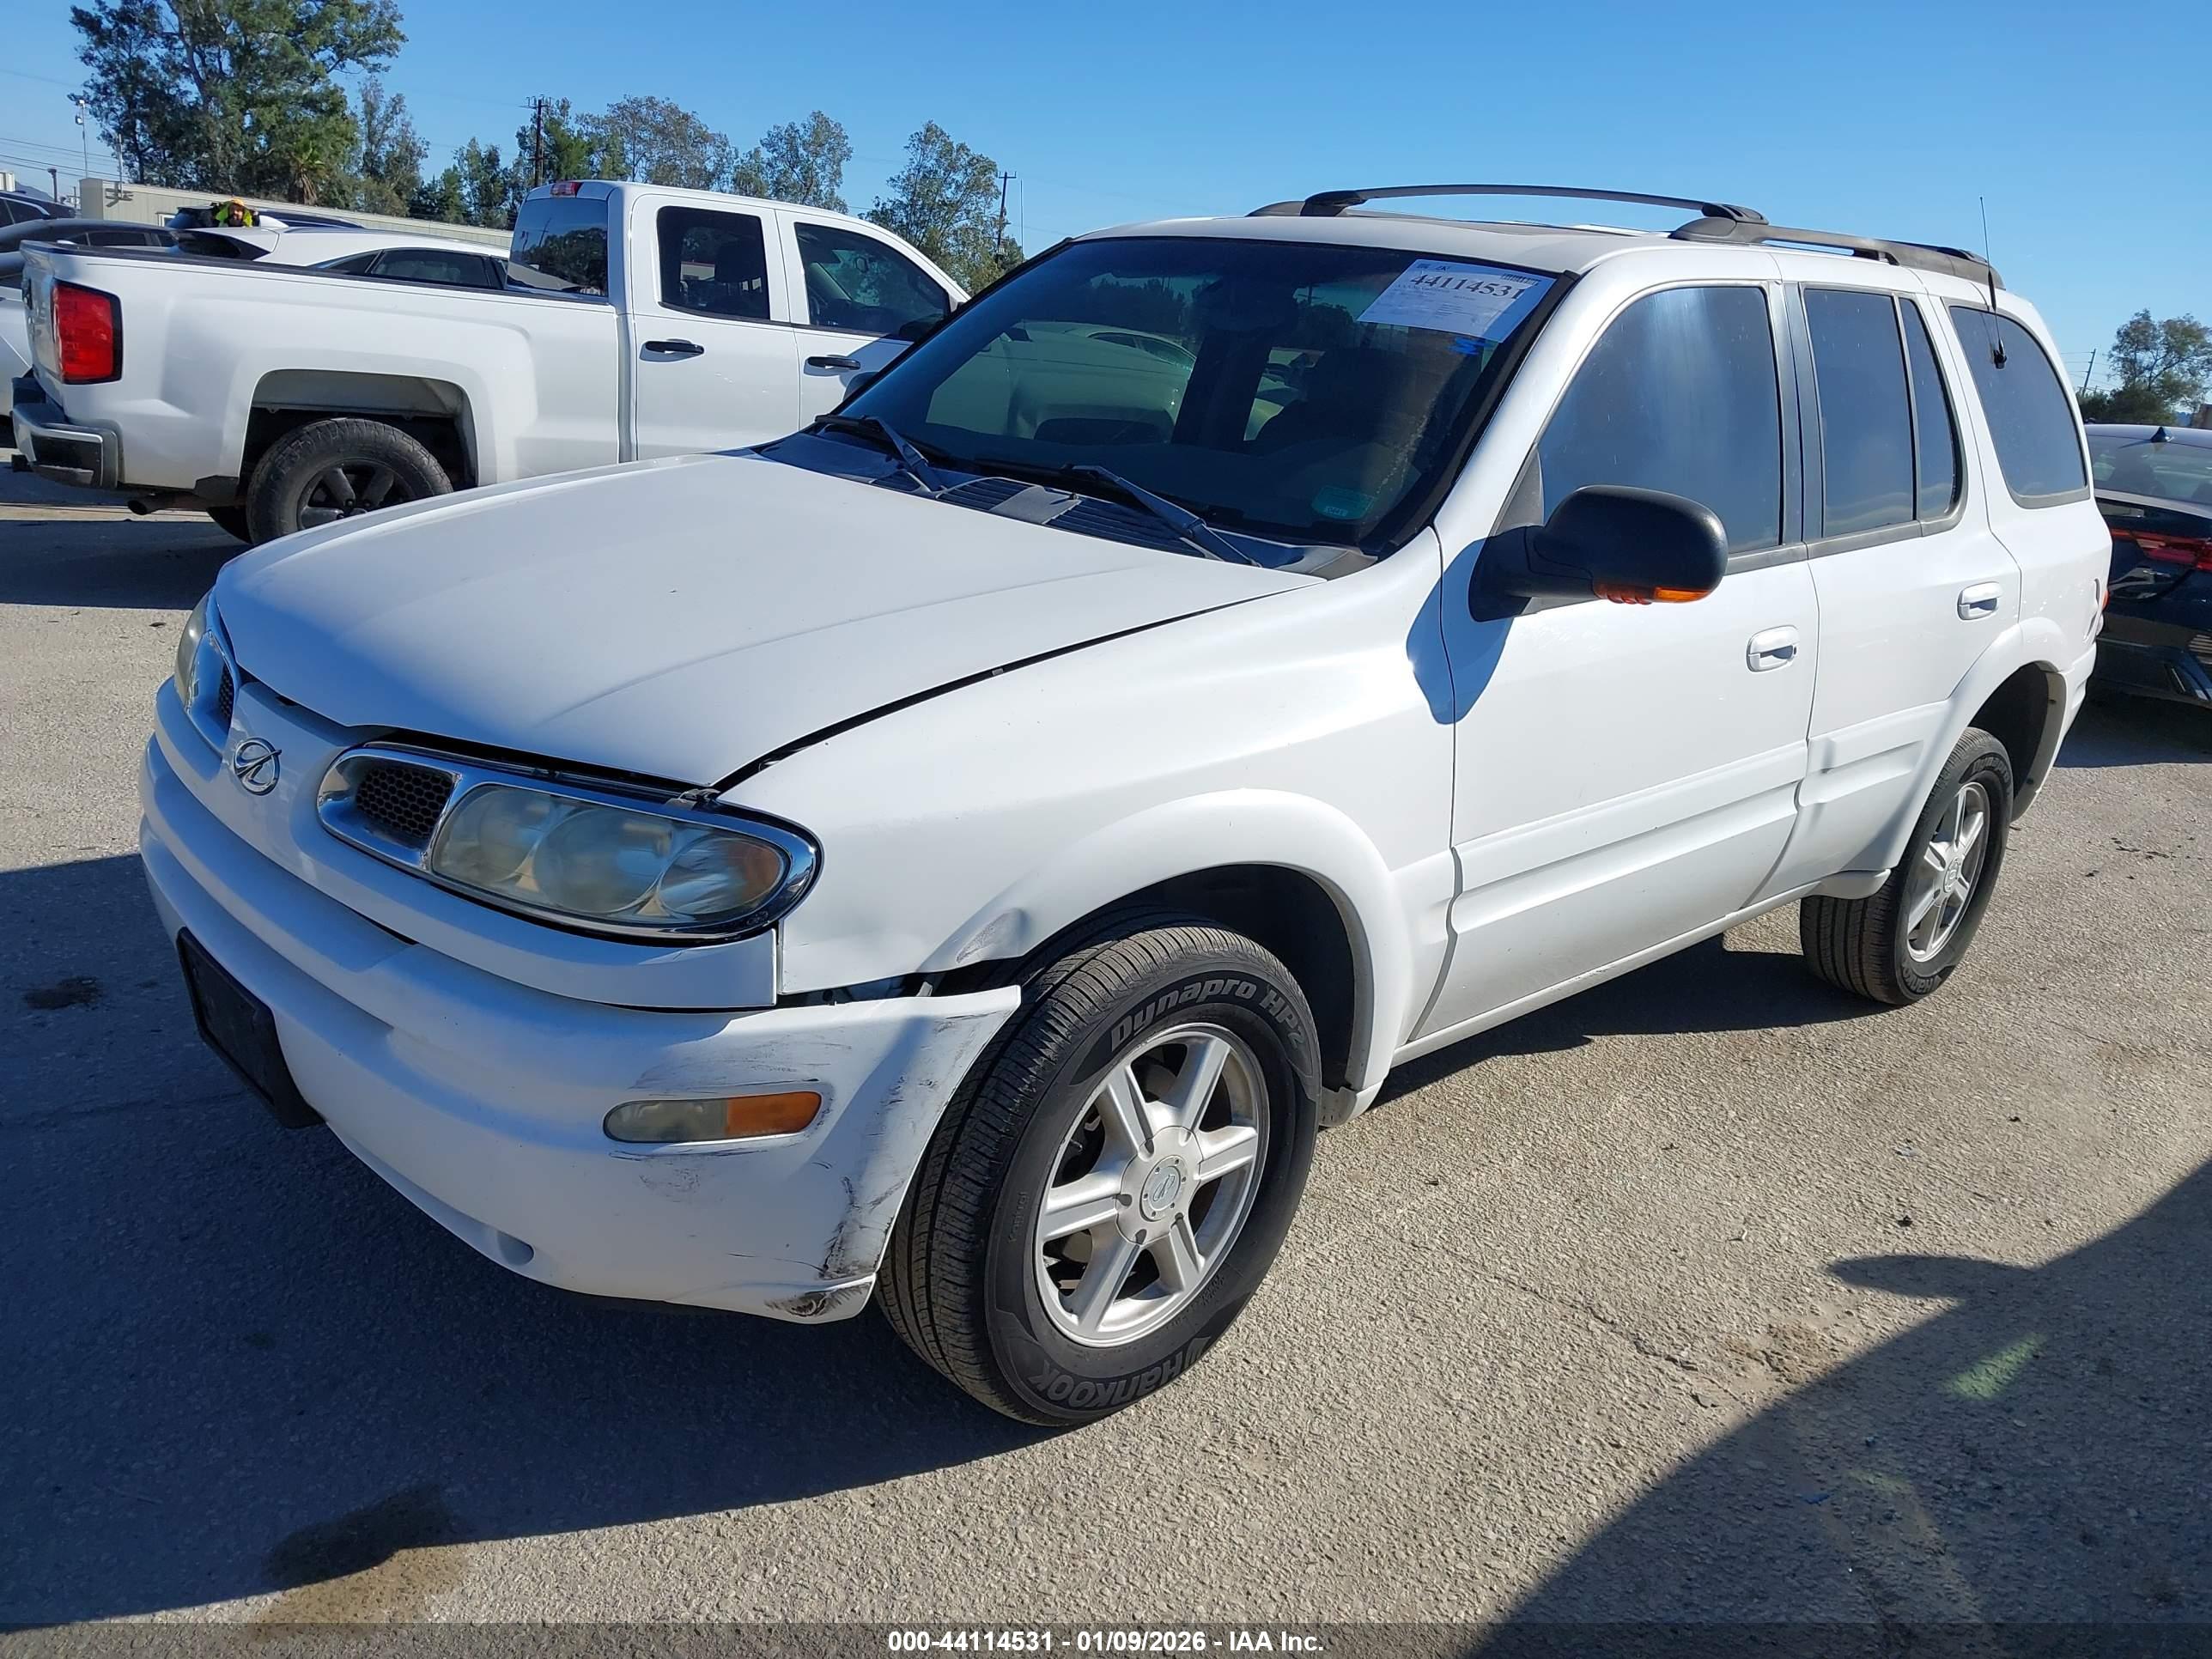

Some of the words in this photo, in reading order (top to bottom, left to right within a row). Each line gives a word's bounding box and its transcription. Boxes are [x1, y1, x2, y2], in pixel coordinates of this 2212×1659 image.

[1410, 274, 1526, 300] 44114531
[1111, 978, 1258, 1052] Dynapro
[1259, 988, 1306, 1049] HP2
